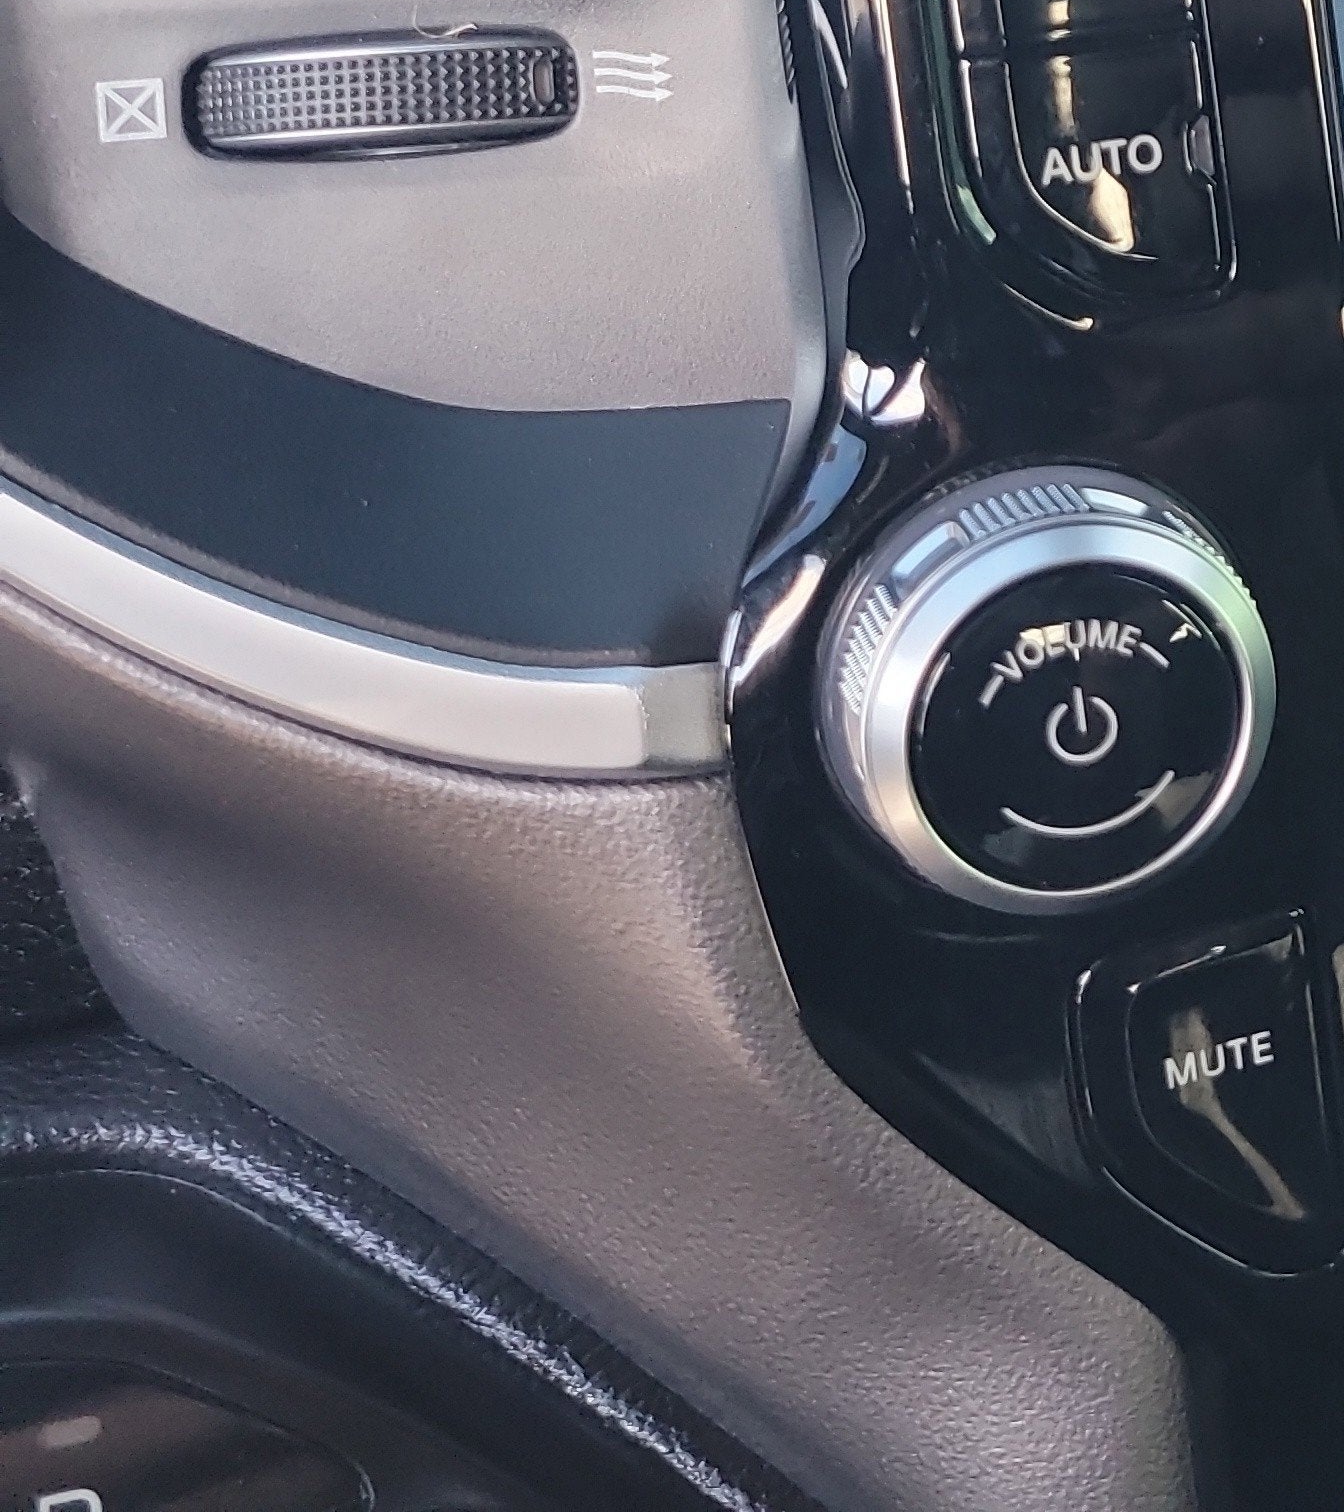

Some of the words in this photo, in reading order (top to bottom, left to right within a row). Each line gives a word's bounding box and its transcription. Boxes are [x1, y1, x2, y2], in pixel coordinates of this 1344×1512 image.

[1041, 134, 1163, 186] AUTO
[990, 617, 1142, 684] VOLUME
[1163, 1031, 1275, 1089] MUTE
